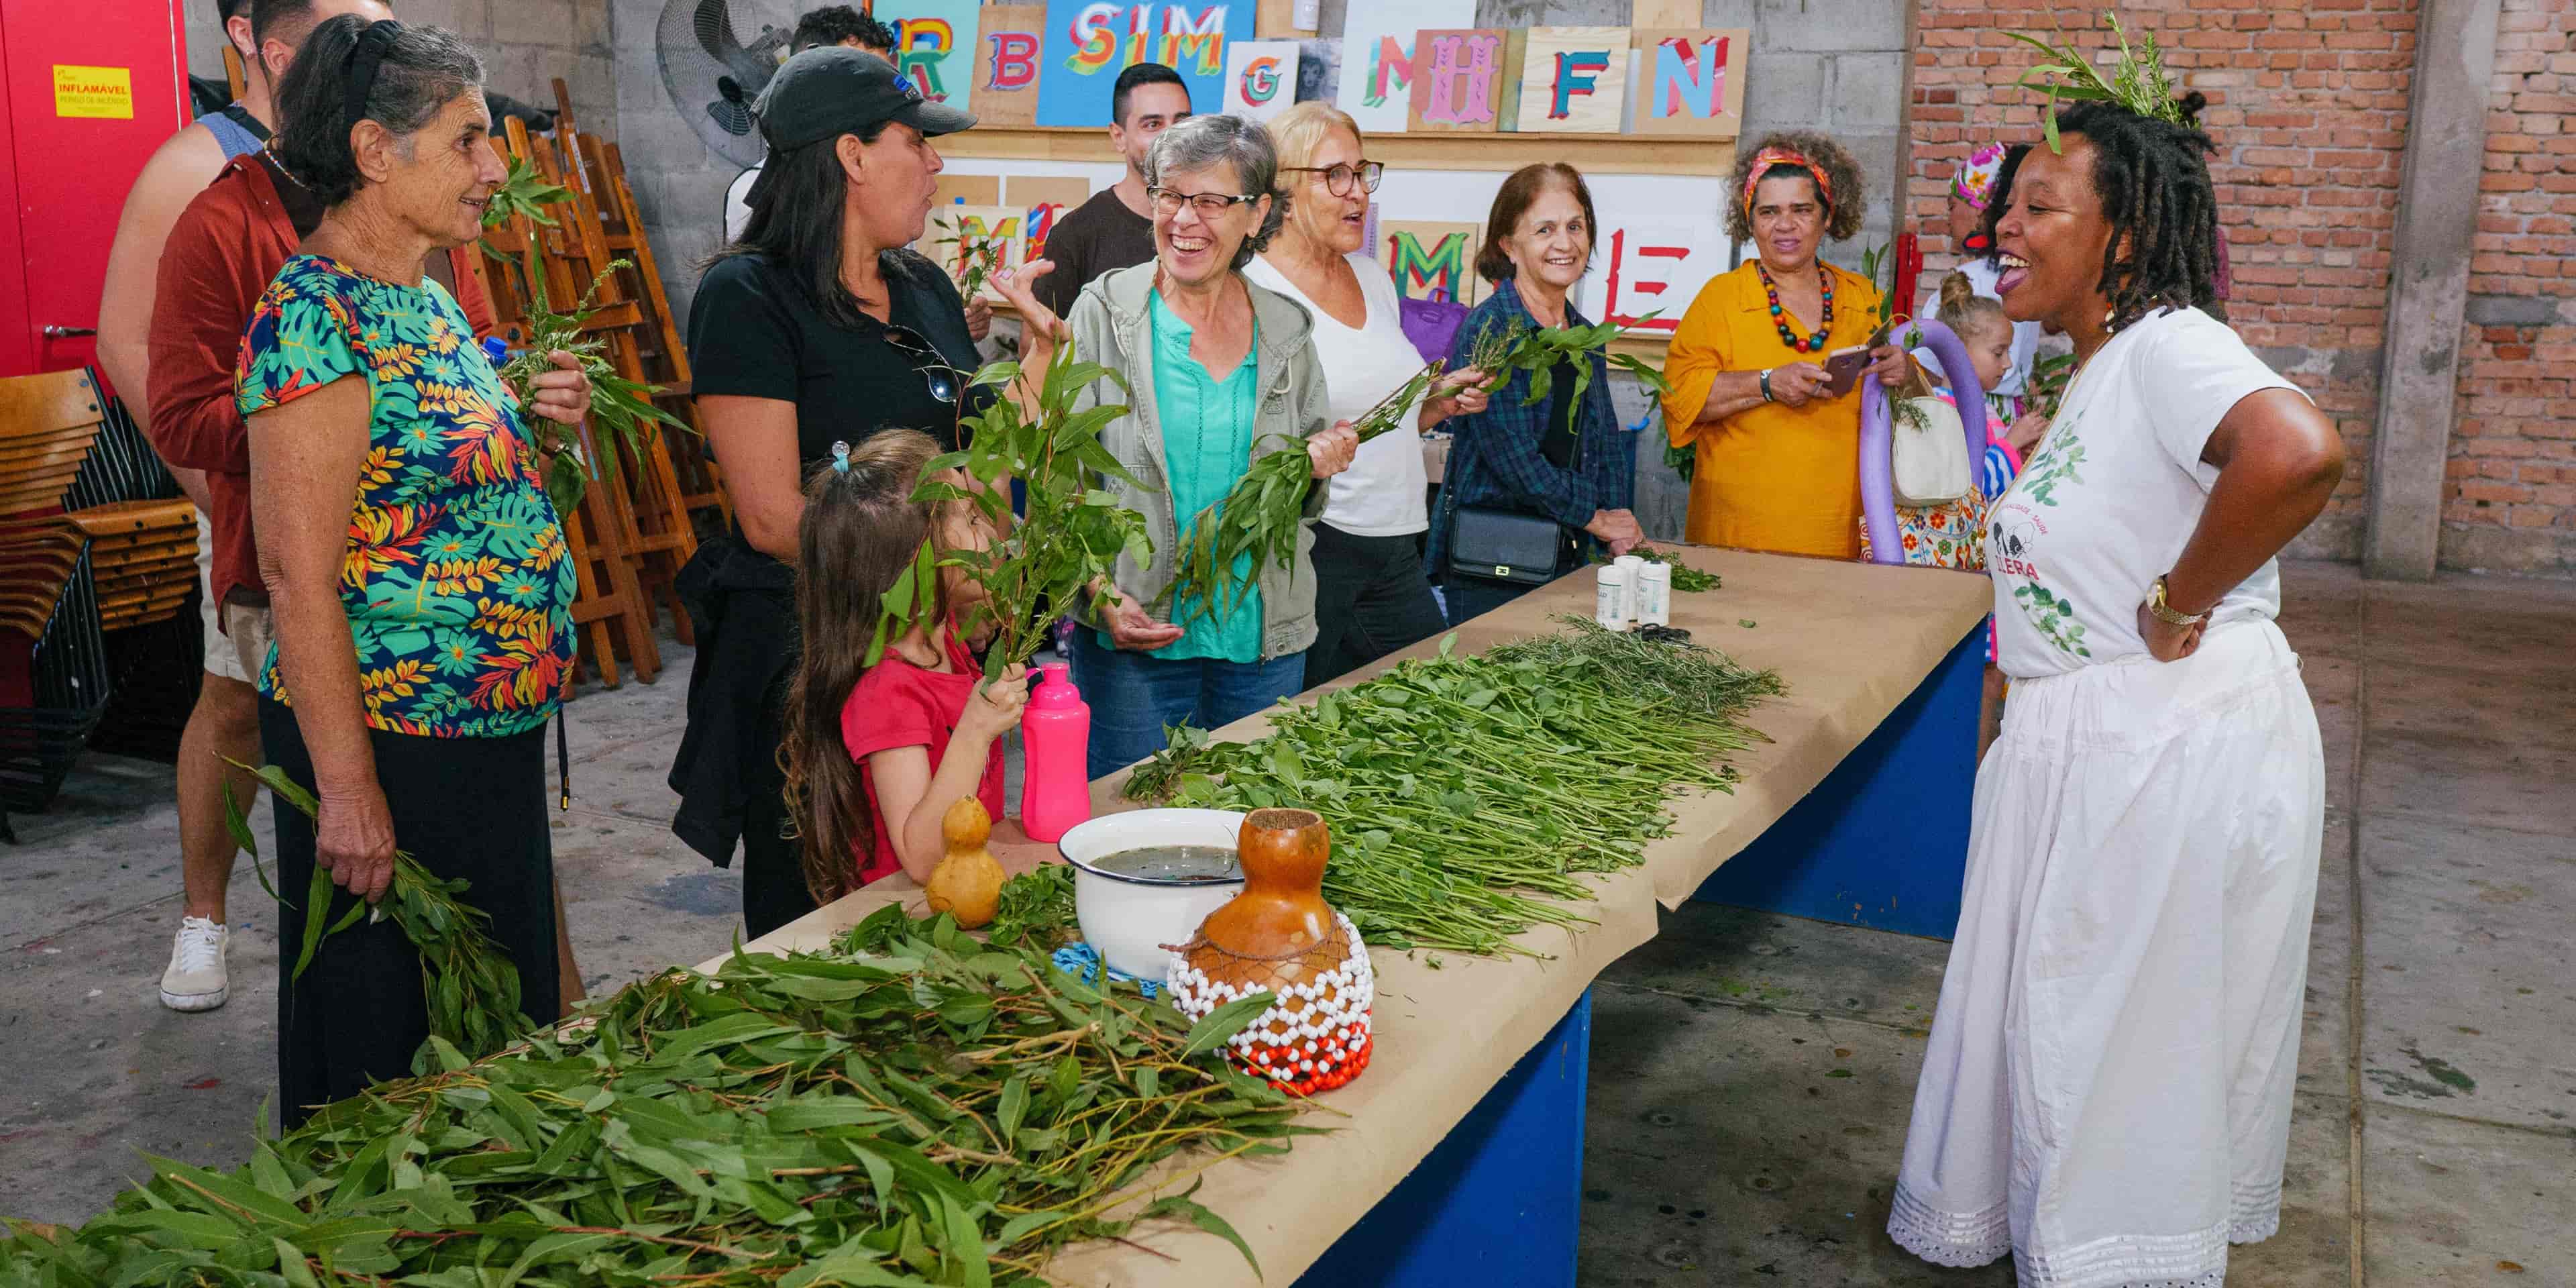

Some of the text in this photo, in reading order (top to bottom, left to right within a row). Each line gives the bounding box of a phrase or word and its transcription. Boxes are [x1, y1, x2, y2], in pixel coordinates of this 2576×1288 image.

[890, 17, 955, 103] R
[981, 31, 1040, 91] B
[1063, 2, 1229, 75] SIM
[1240, 56, 1283, 107] G
[1422, 34, 1501, 127] H
[1547, 49, 1611, 119] F
[1652, 36, 1730, 118] N
[955, 215, 1020, 279] M
[1388, 231, 1470, 303] M
[1605, 228, 1690, 333] E
